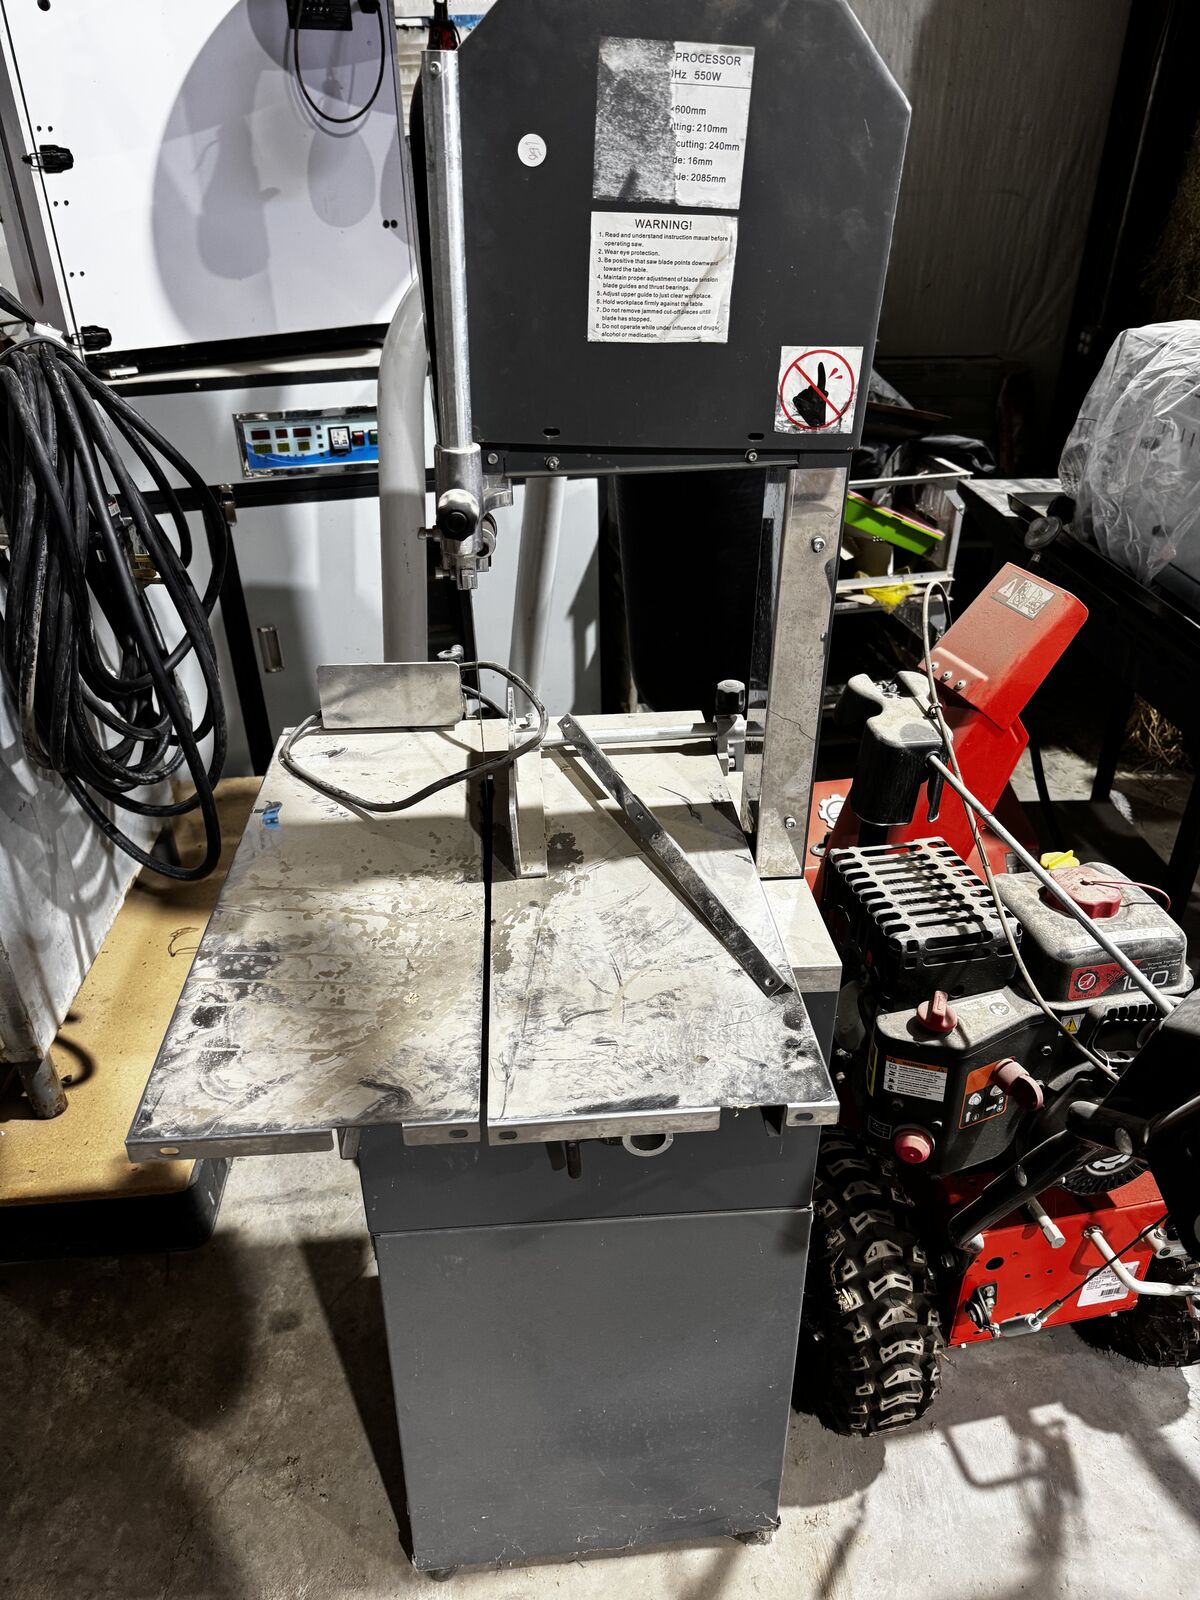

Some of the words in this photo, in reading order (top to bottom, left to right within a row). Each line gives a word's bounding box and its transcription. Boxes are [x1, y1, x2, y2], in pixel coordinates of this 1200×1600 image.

[675, 53, 741, 66] PROCESSOR
[694, 71, 721, 81] 550W
[697, 124, 727, 134] 210mm
[676, 141, 707, 150] cutting:
[709, 142, 739, 151] 240mm
[688, 157, 712, 166] 16mm
[691, 174, 726, 183] 2085mm
[635, 219, 692, 230] WARNING!
